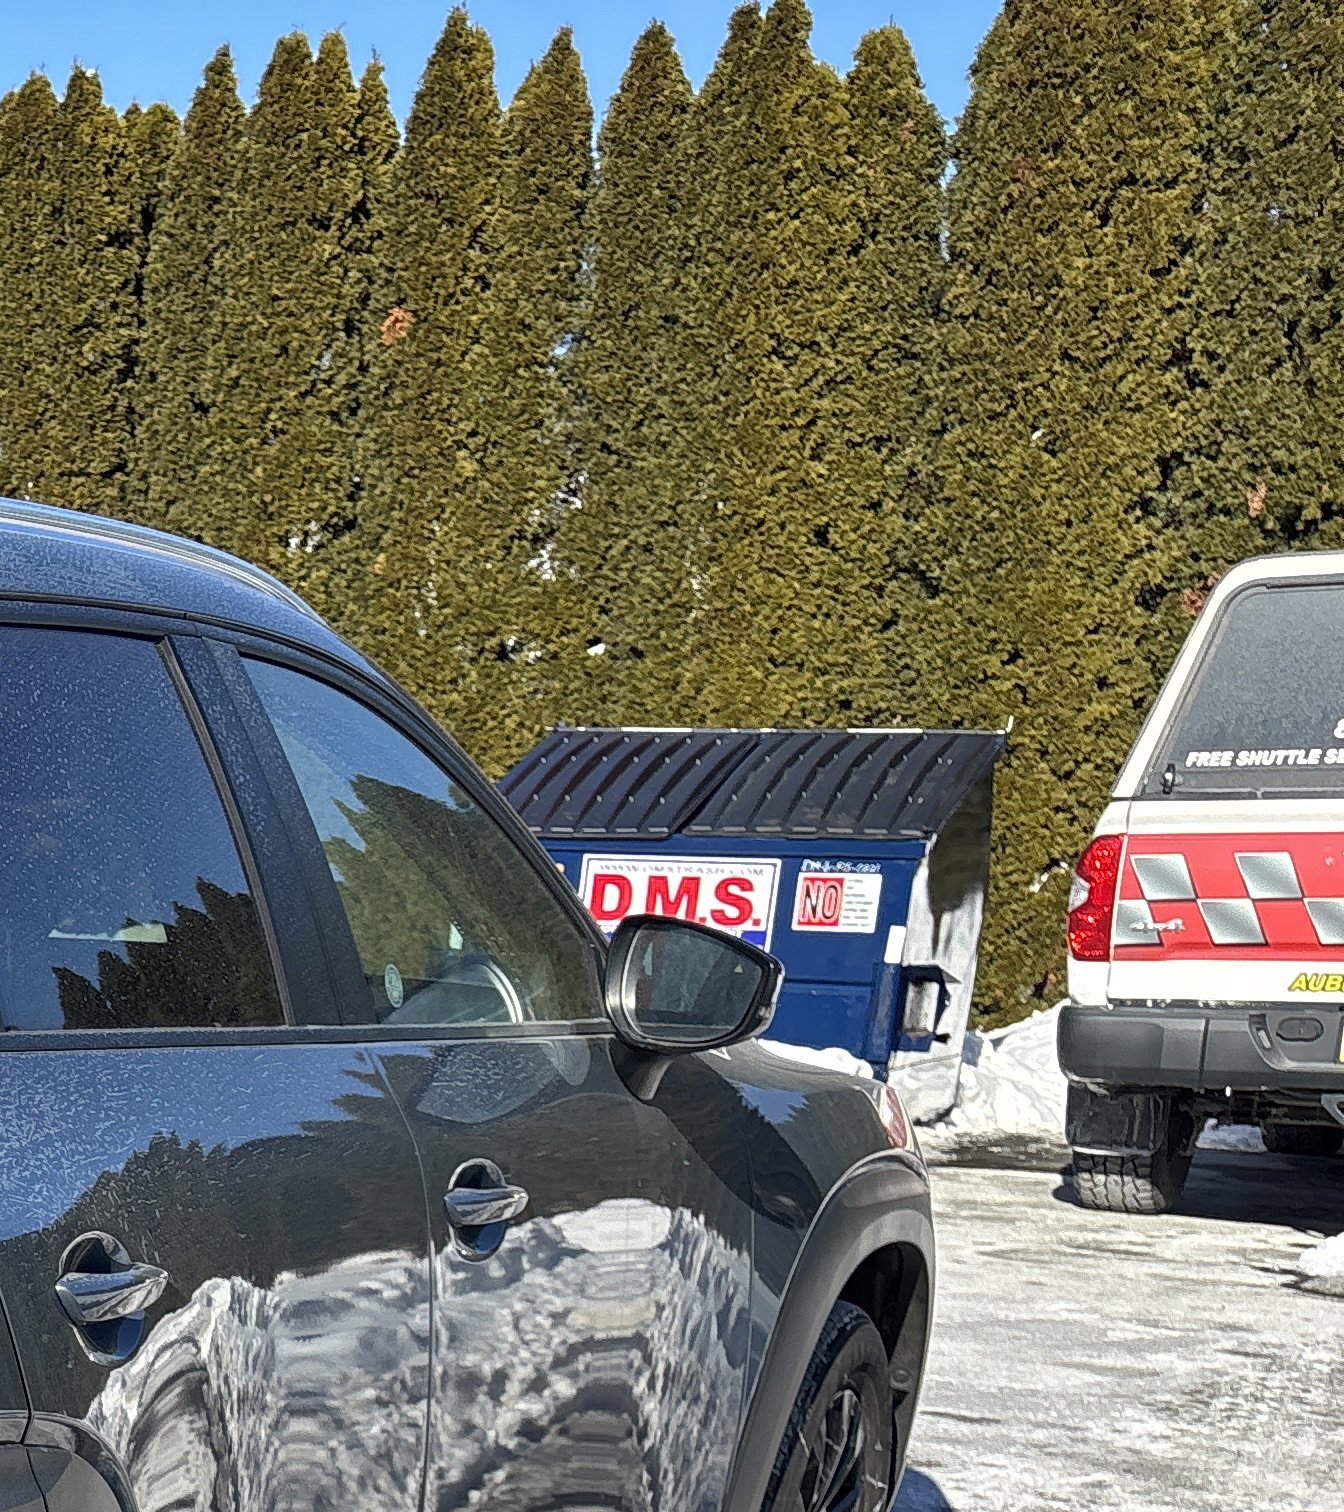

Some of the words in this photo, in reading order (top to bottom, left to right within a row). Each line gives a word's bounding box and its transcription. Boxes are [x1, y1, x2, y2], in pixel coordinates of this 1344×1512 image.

[1185, 750, 1235, 768] FREE
[1236, 748, 1322, 766] SHUTTLE
[590, 873, 761, 926] DM.S.
[799, 880, 841, 923] NO
[1288, 972, 1344, 992] AUB
